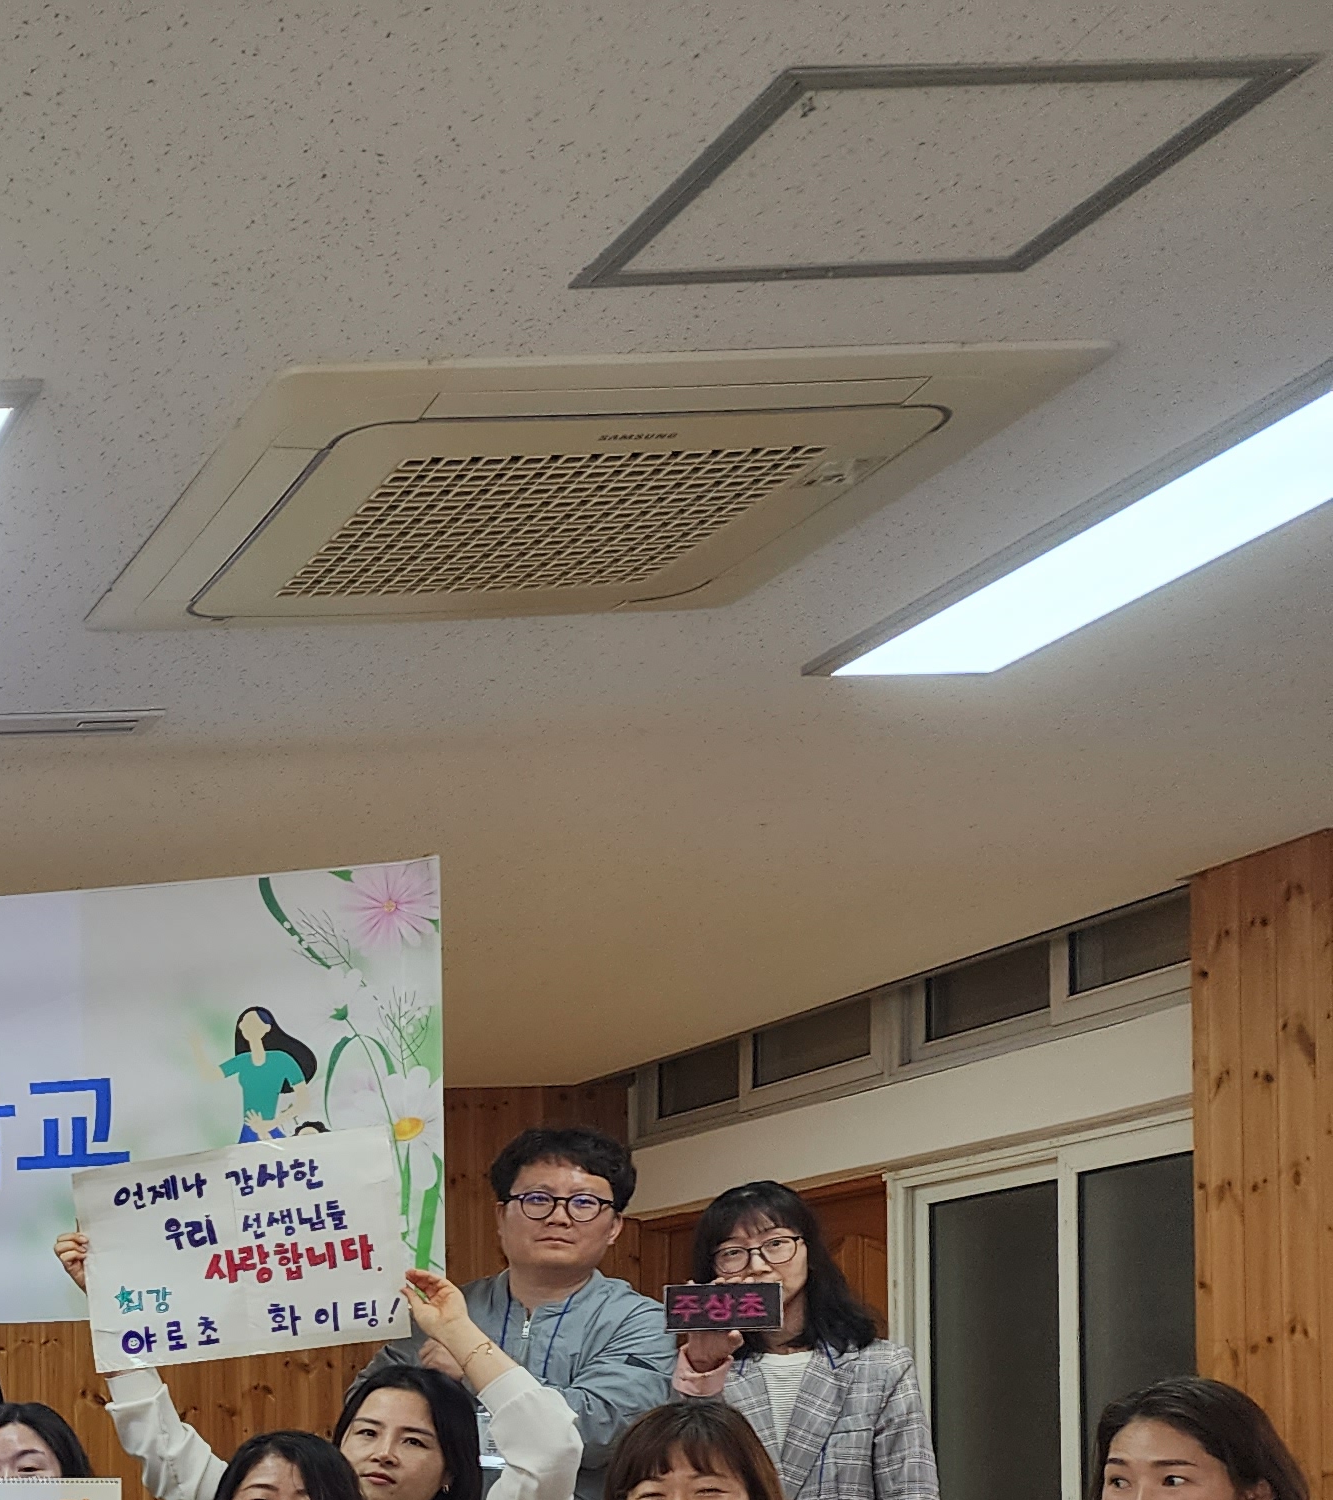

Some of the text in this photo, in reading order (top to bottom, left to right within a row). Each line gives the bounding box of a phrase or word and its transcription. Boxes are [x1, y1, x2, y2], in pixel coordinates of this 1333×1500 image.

[114, 1158, 324, 1210] 언제나 감사한
[165, 1200, 348, 1250] 우리 선생님들
[115, 1286, 172, 1314] 최강
[671, 1292, 769, 1322] 주상초
[122, 1297, 401, 1355] 야로초 화이팅!
